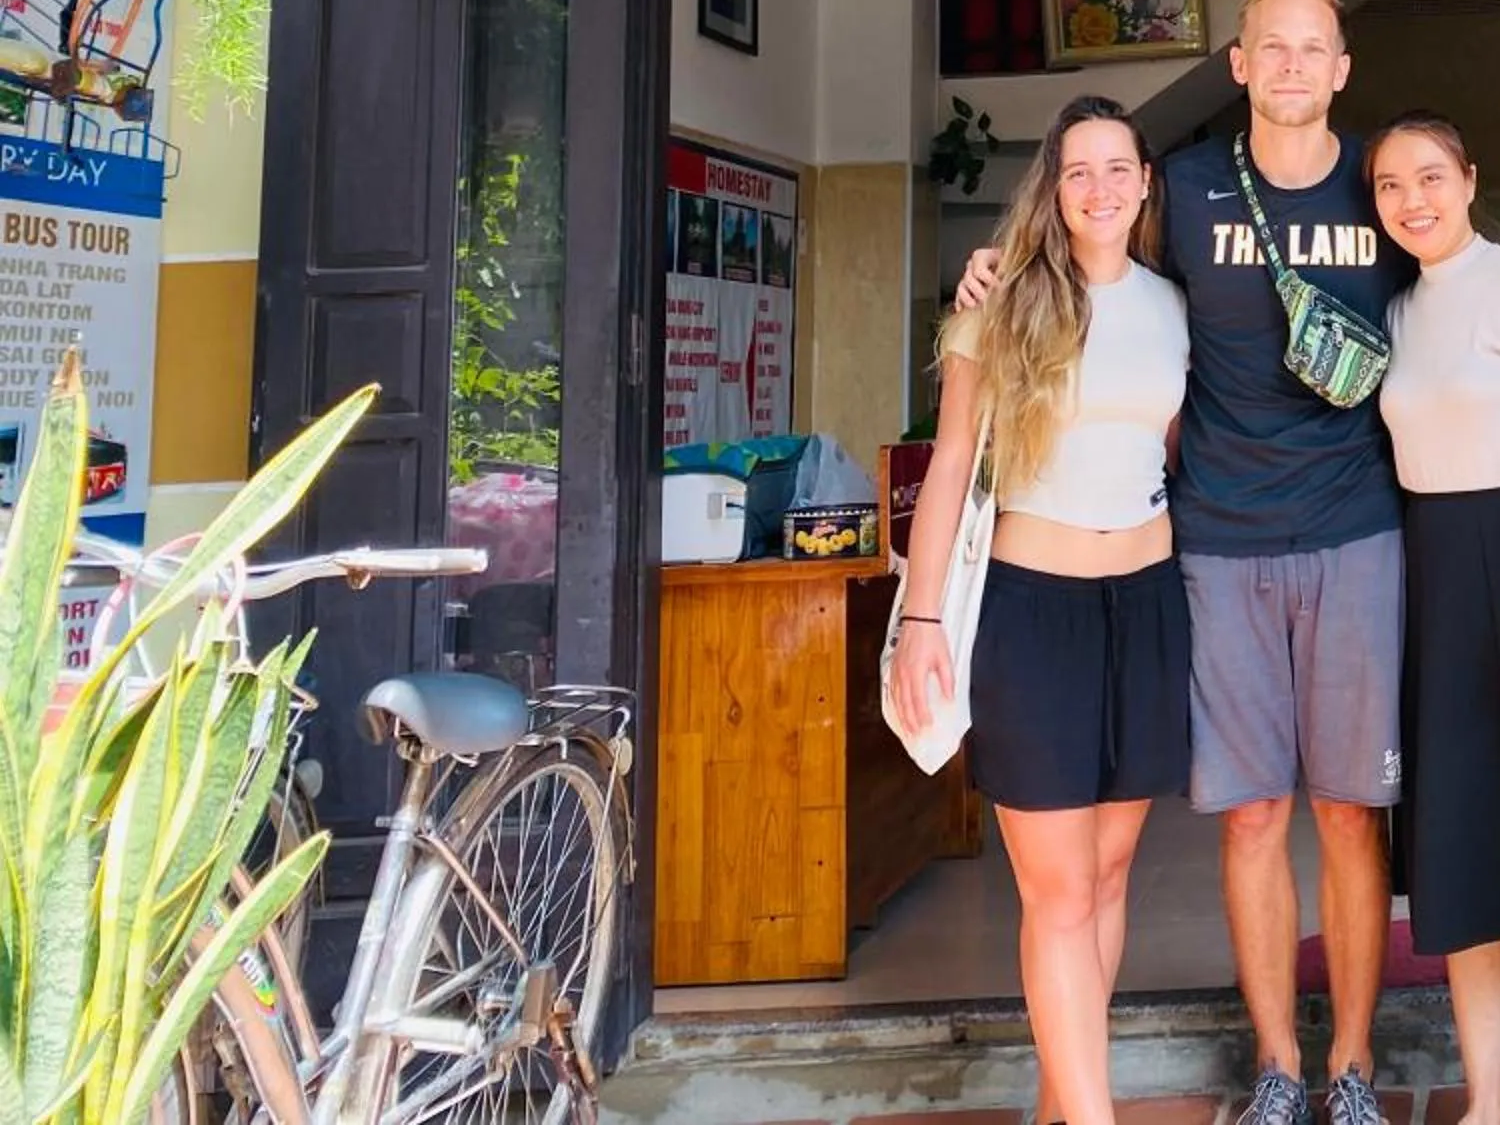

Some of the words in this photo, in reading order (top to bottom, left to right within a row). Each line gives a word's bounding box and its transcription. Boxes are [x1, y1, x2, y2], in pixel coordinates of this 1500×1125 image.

[47, 152, 107, 187] DAY
[708, 162, 774, 203] HOMESTAY
[4, 213, 58, 248] BUS
[67, 219, 130, 256] TOUR
[1213, 223, 1378, 267] THLAND
[56, 262, 127, 283] TRANG
[37, 281, 74, 300] LAT
[97, 391, 135, 408] NOI
